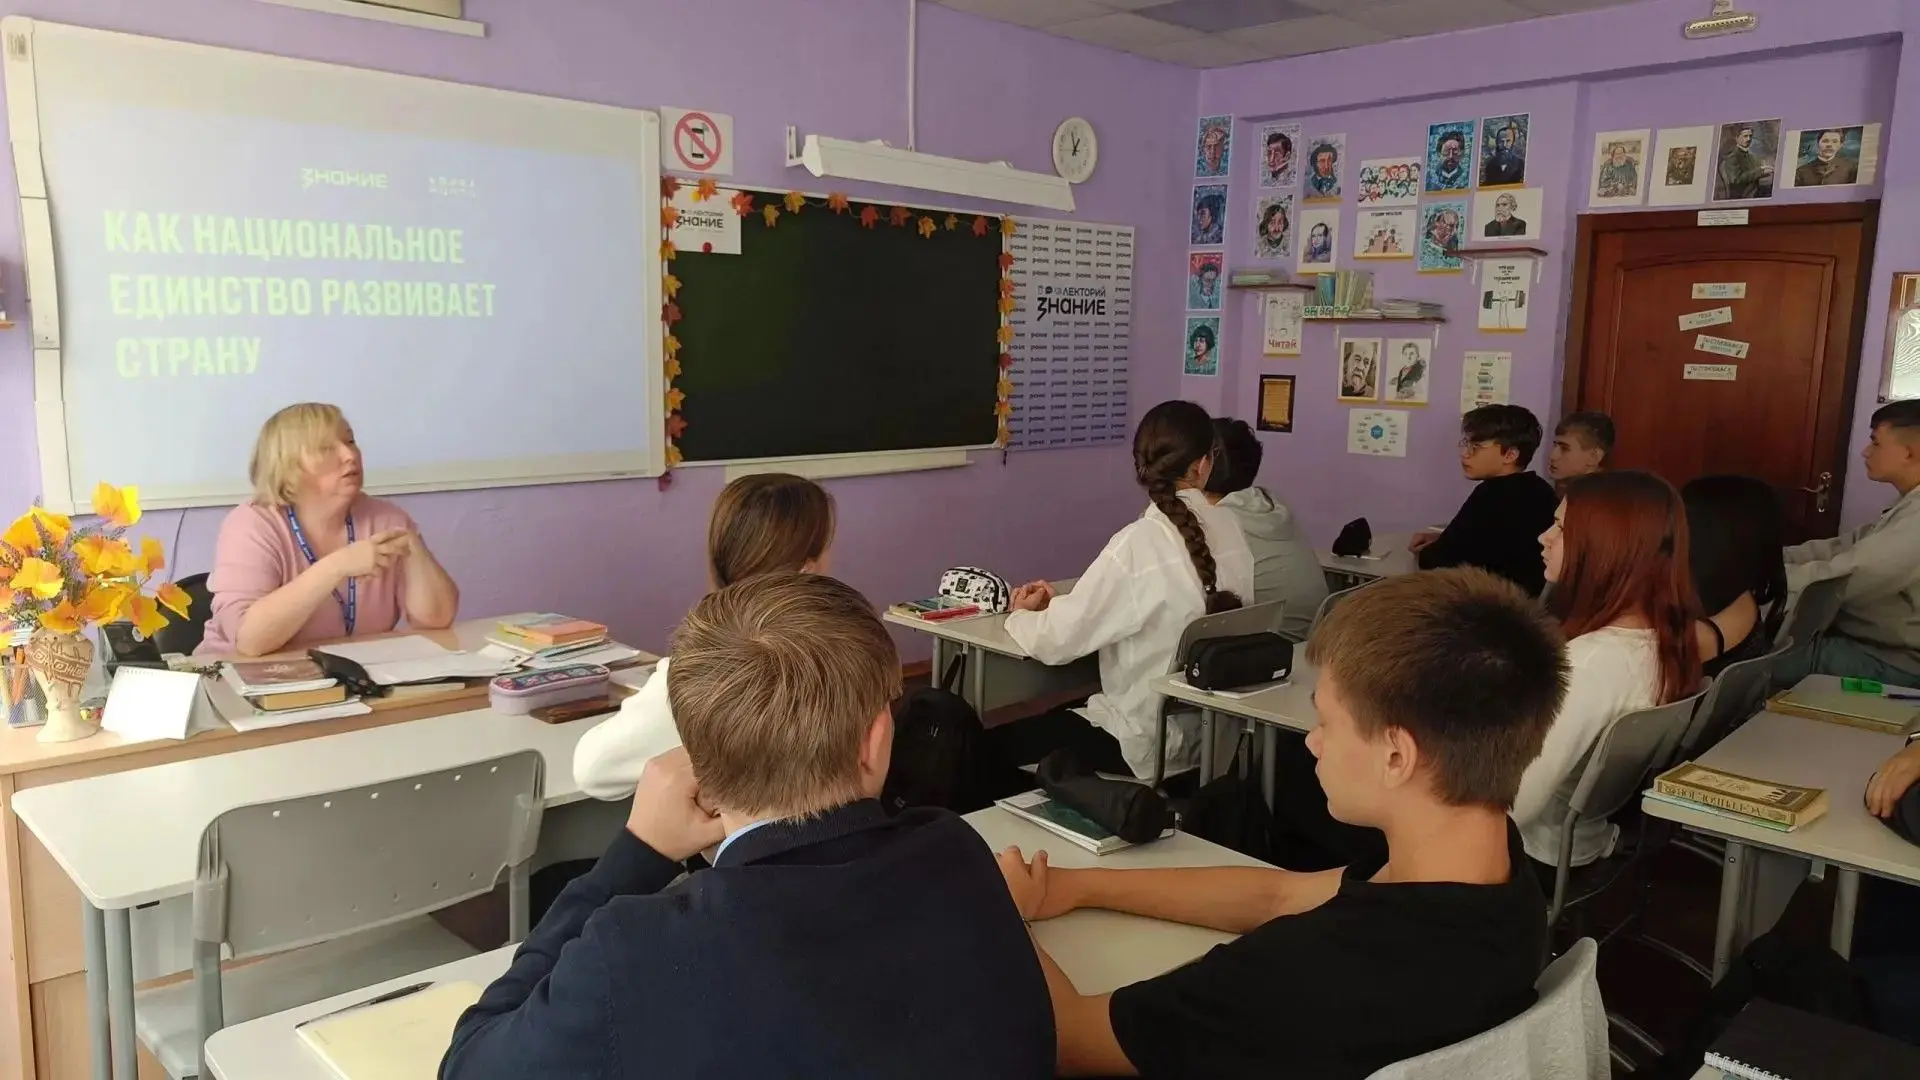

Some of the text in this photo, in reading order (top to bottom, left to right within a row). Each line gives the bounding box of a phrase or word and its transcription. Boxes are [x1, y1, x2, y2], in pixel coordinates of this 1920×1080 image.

[103, 210, 465, 264] КАК НАЦИОНАЛЬНОЕ
[109, 273, 497, 323] ЕДИНСТВО РАЗВИВАЕТ
[1063, 286, 1106, 298] ЛЕКТОРИЙ
[115, 336, 261, 379] СТРАНУ
[1269, 338, 1297, 349] Читай
